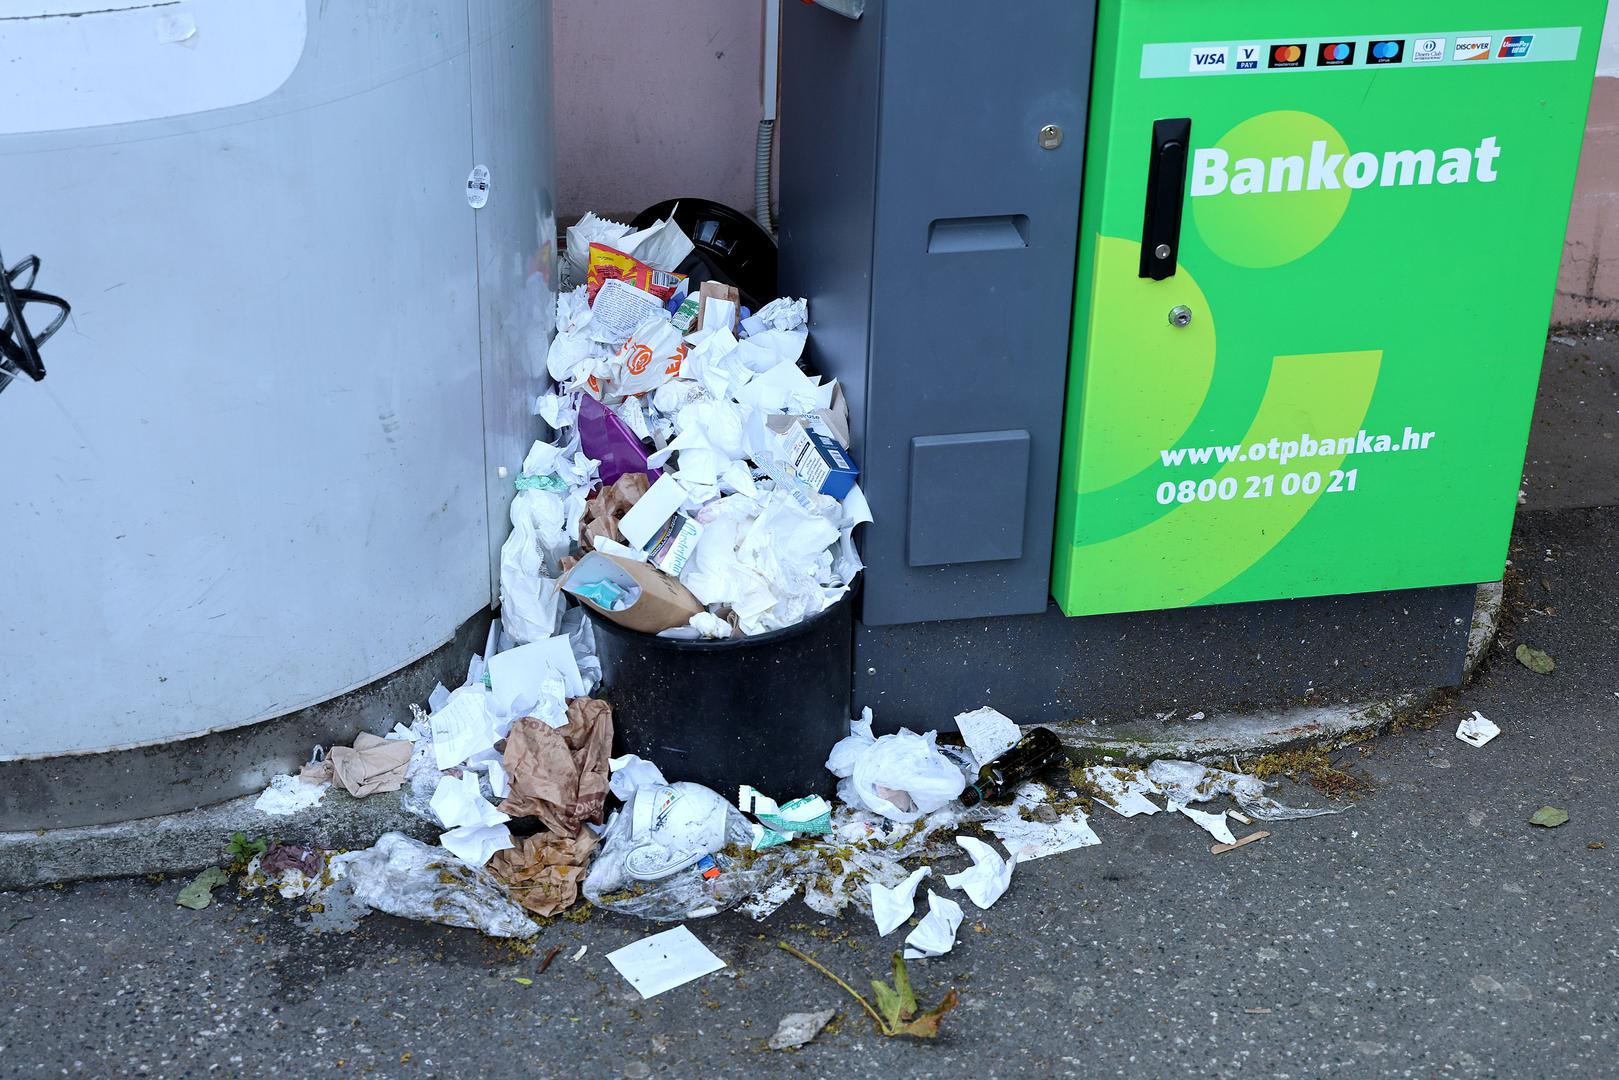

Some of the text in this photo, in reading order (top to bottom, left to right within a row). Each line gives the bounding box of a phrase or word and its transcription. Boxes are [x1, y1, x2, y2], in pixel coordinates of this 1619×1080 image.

[1456, 42, 1489, 51] DISCOVER
[1502, 41, 1530, 49] UnionPay
[1194, 53, 1225, 66] VISA
[1243, 48, 1254, 59] V
[1190, 135, 1501, 197] Bankomat
[1159, 426, 1436, 468] www.otpbanka.hr
[1156, 467, 1359, 506] 0800 21 00 21
